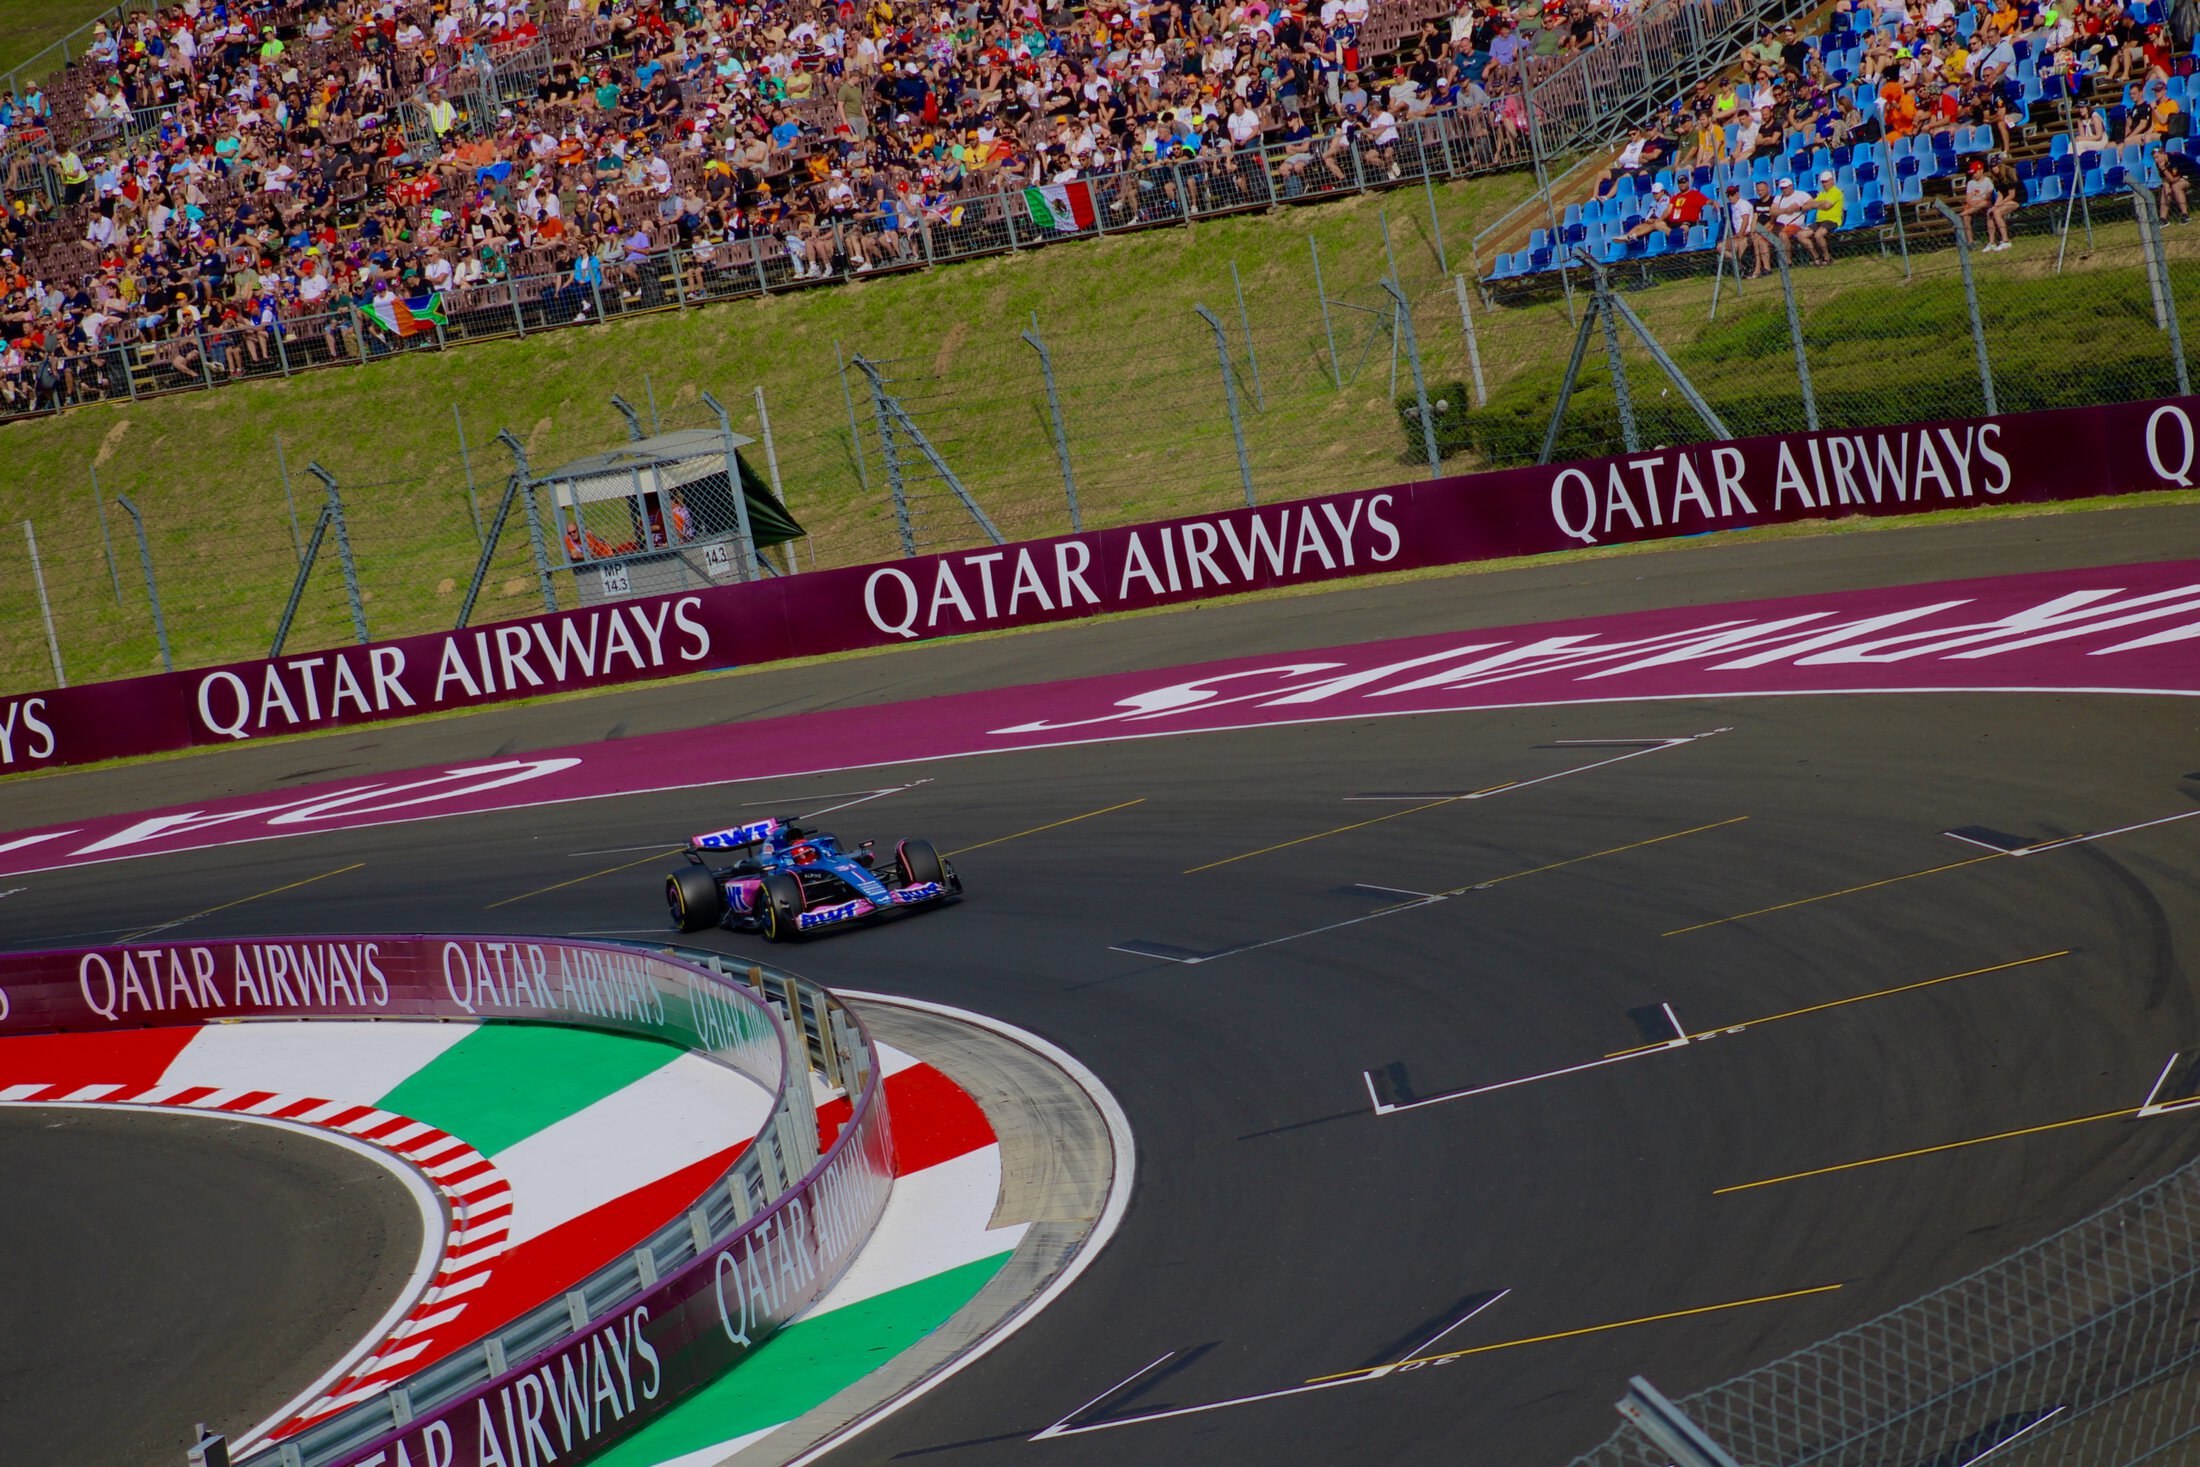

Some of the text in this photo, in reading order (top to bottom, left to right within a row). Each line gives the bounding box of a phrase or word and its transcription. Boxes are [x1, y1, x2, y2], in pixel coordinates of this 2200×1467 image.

[1551, 423, 2011, 544] QATAR AIRWAYS
[604, 563, 622, 577] MP
[604, 578, 628, 592] 14.3
[705, 547, 727, 566] 14.3
[864, 494, 1400, 638] QATAR AIRWAYS
[198, 596, 711, 739] QATAR AIRWAYS
[80, 946, 225, 1021] QATAR
[235, 943, 389, 1007] AIRWAYS
[442, 941, 665, 1026] QATAR AIRWAYS
[715, 1197, 815, 1348] QATAR
[480, 1305, 660, 1467] AIRWAYS
